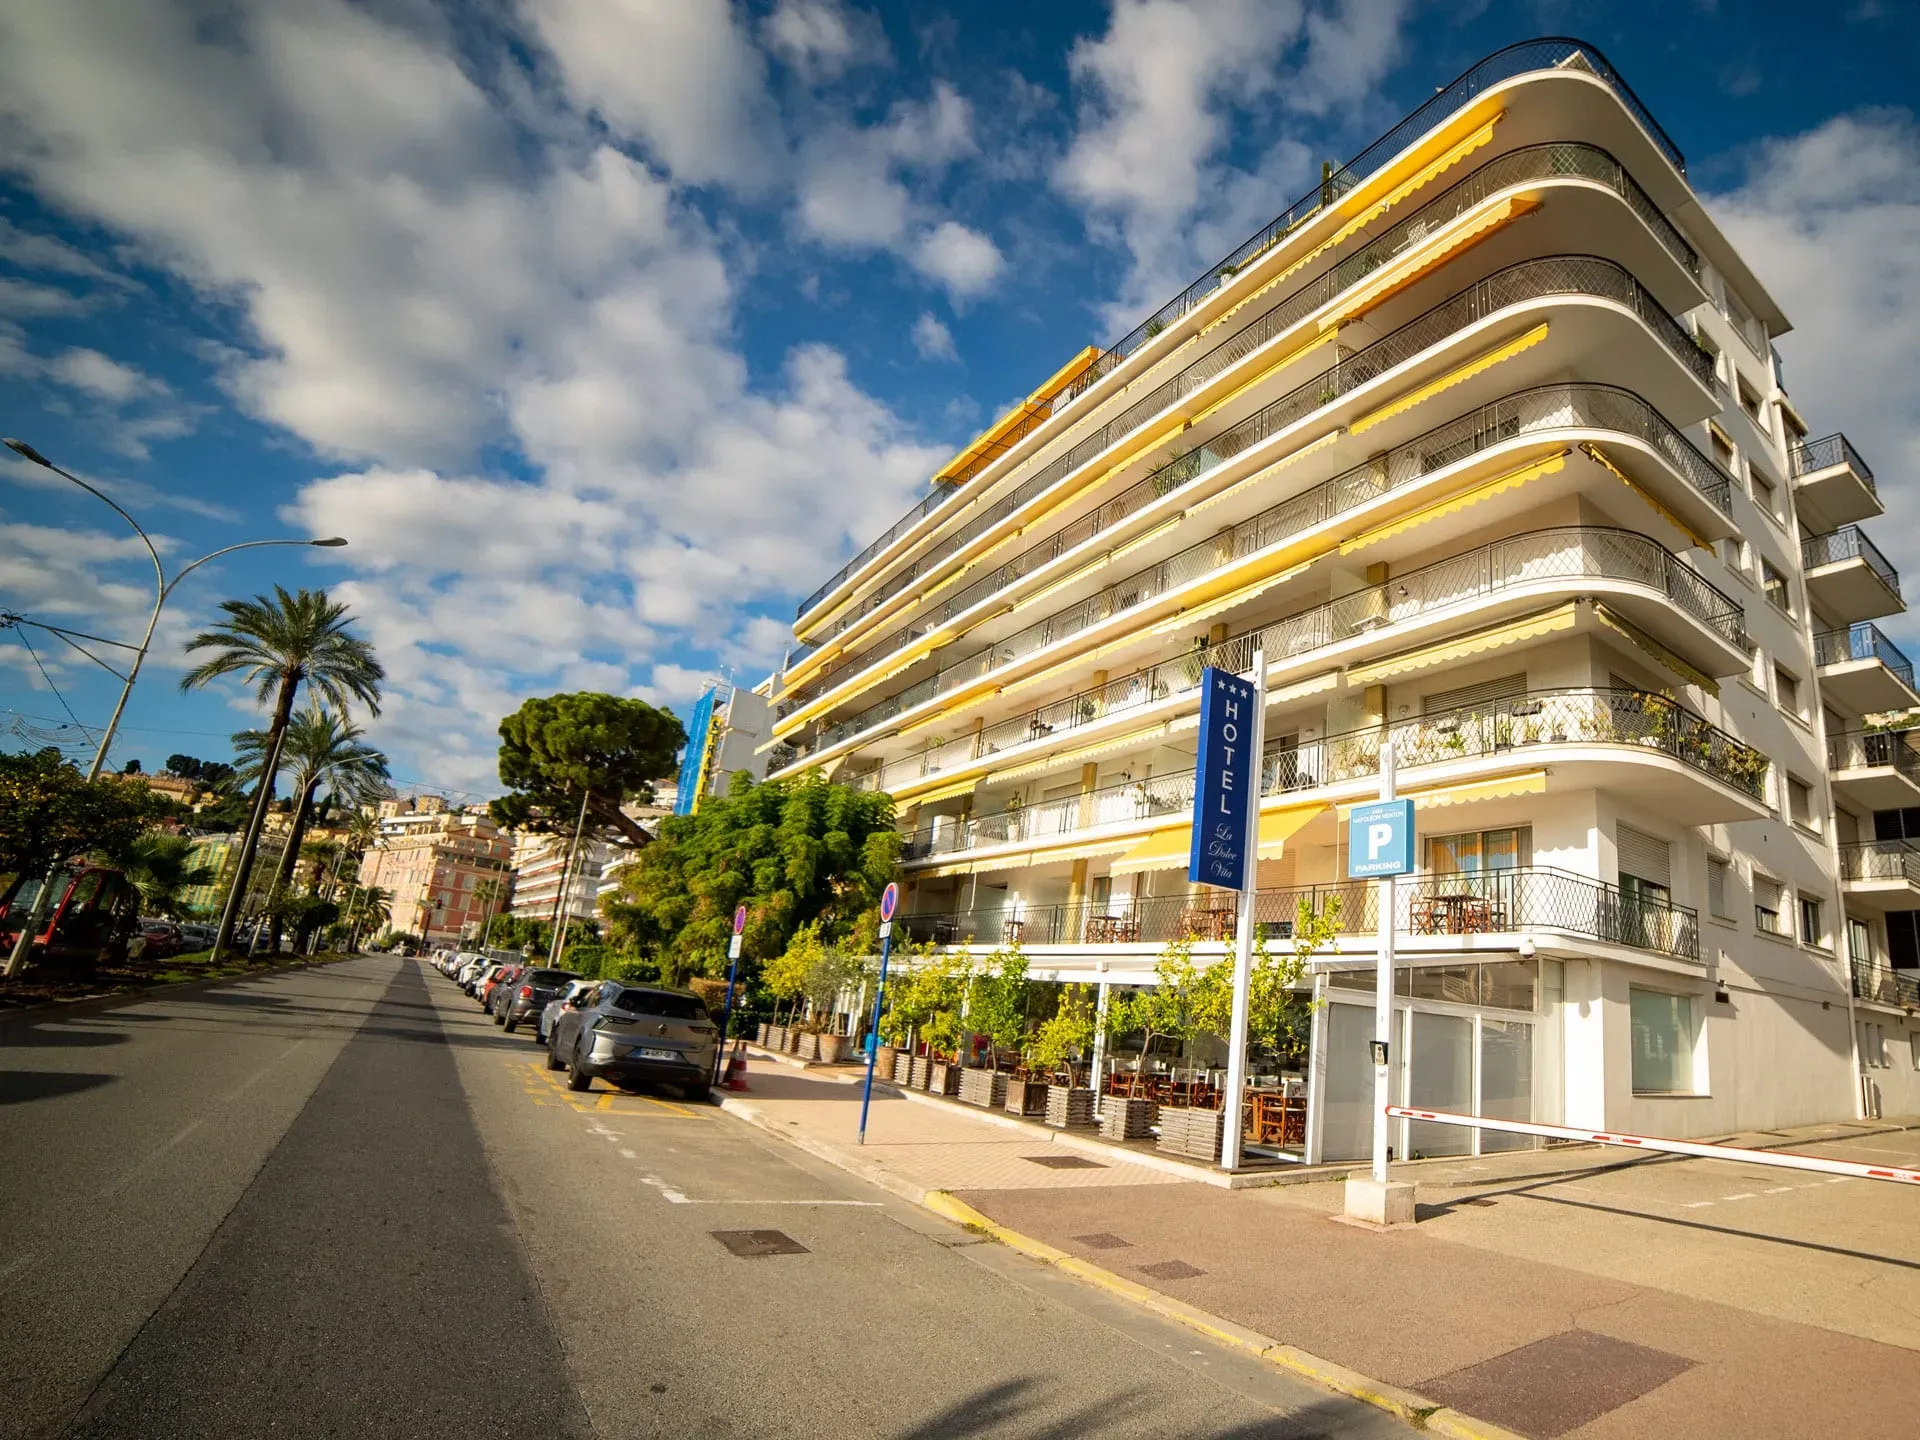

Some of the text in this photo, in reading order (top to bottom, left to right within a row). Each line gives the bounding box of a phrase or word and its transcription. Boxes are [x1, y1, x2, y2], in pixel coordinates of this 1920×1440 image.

[1219, 699, 1238, 815] HOTEL
[1214, 823, 1233, 841] La
[1368, 823, 1392, 860] P
[1208, 841, 1237, 861] Dolce
[1210, 861, 1233, 880] Vita
[1355, 861, 1401, 873] PARKING
